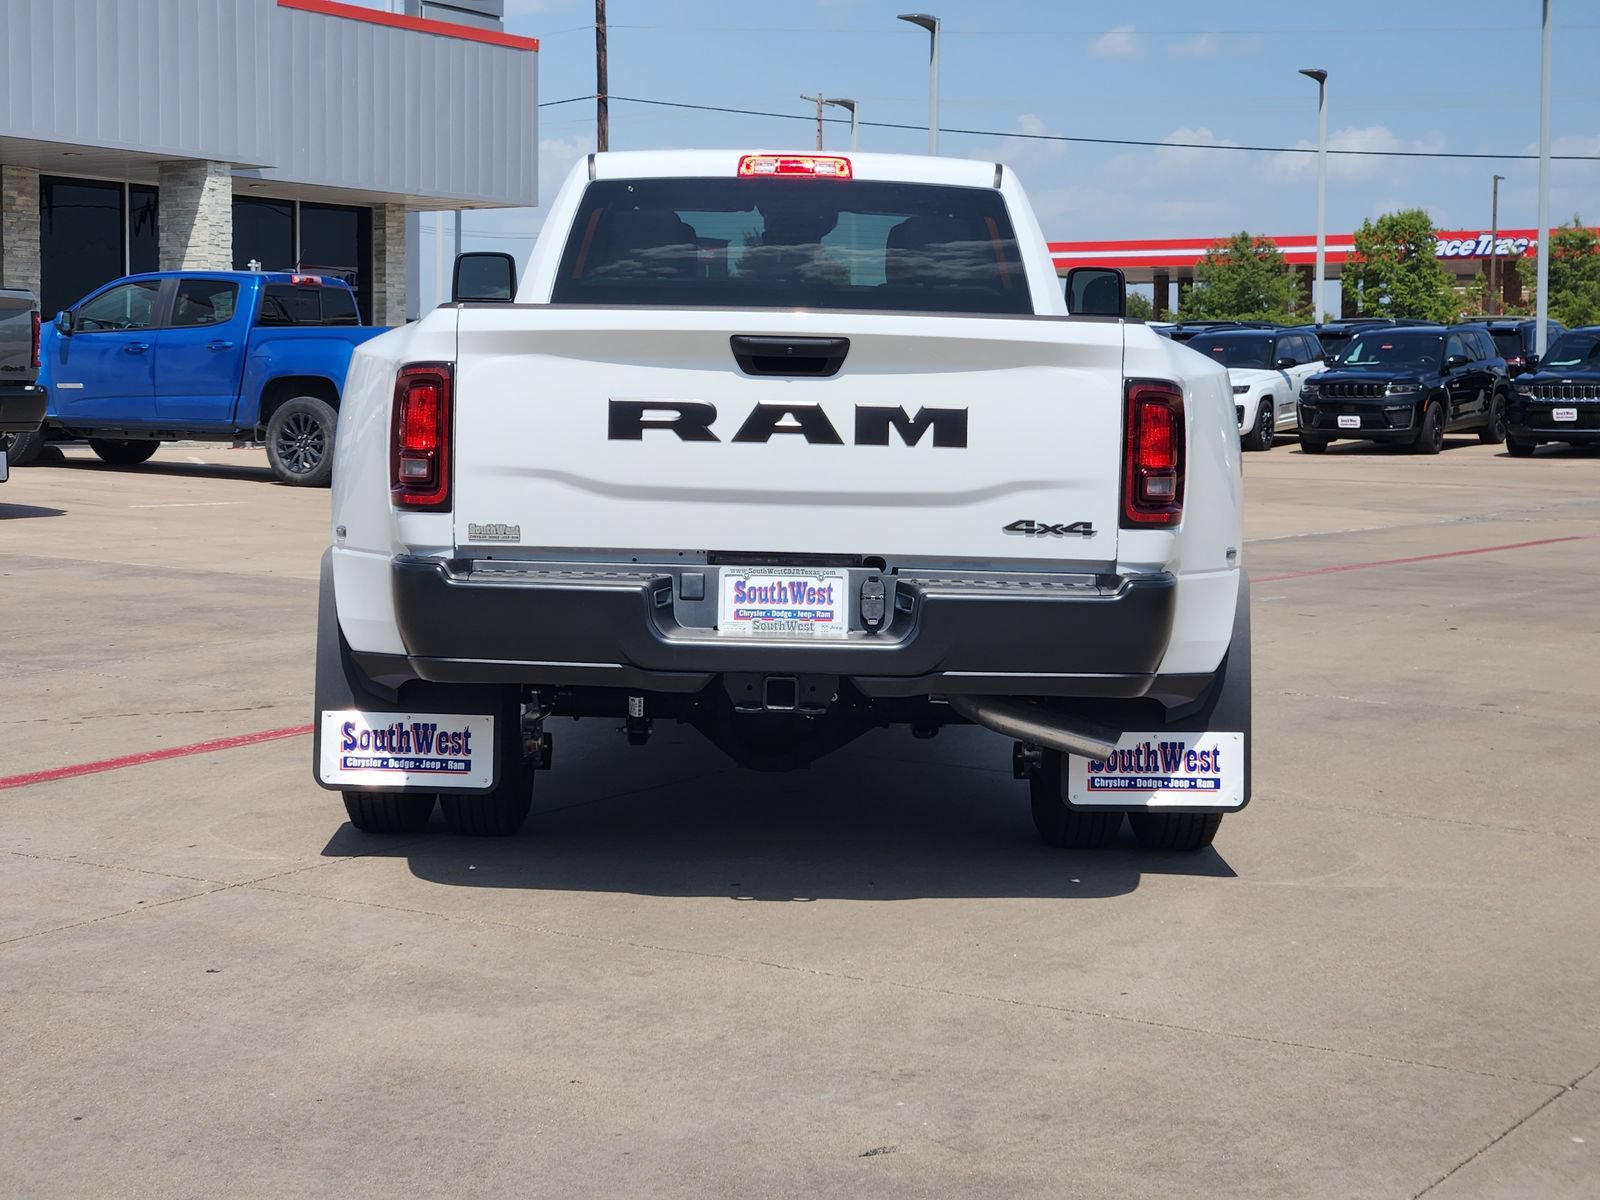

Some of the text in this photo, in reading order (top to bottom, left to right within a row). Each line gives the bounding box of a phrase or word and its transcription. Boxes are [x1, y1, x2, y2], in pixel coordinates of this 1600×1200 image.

[1432, 233, 1528, 256] aceTrac
[607, 398, 969, 448] RAM
[468, 523, 520, 535] SouthWest
[1002, 519, 1098, 537] 4x4
[734, 580, 834, 606] SouthWest
[738, 609, 767, 618] Chrysler
[771, 609, 792, 618] Dodge
[797, 610, 812, 618] Jeep
[752, 620, 815, 632] SouthWest
[340, 721, 472, 756] SouthWest
[346, 757, 465, 770] Chrysler Dodge Jeep Ram
[1094, 777, 1215, 789] Chrysler Dodge Jeep Ram
